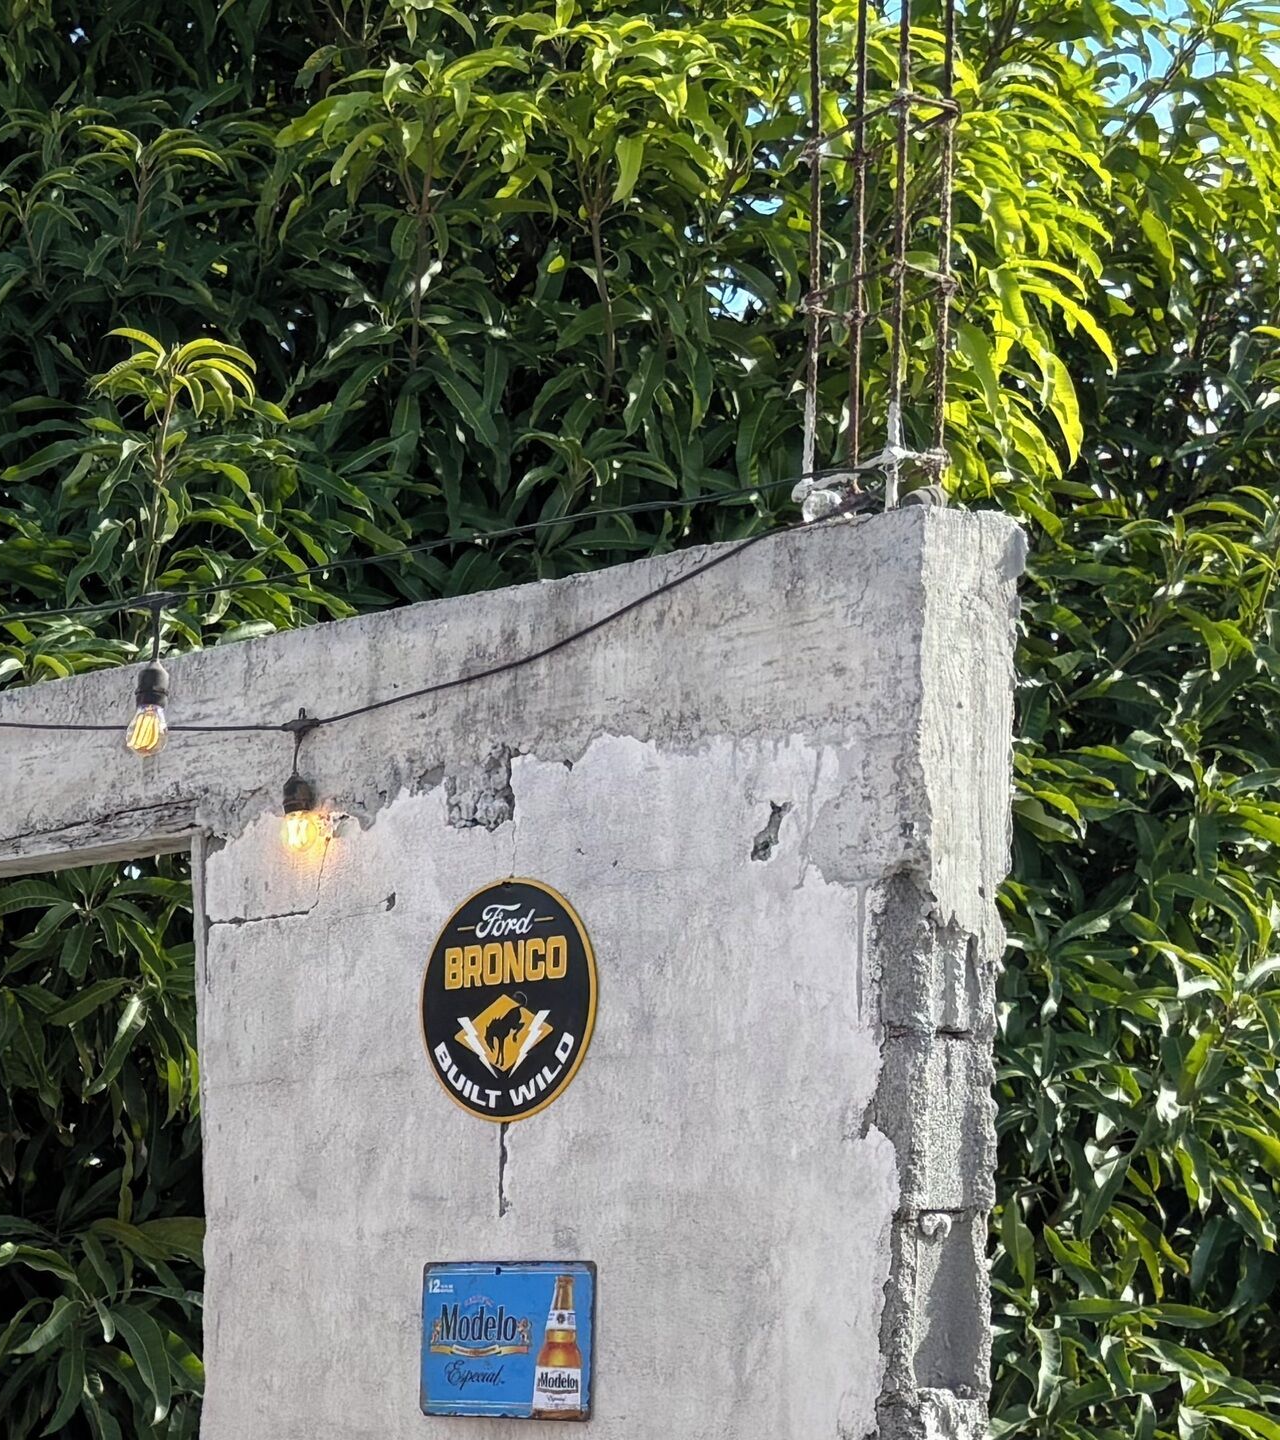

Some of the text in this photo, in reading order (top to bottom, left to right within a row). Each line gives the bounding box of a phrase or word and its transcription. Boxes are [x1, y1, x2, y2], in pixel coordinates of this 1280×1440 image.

[475, 903, 536, 938] Ford
[444, 935, 568, 990] BRONCO
[434, 1031, 575, 1108] BUILT WILD
[440, 1303, 517, 1342] Modelo
[540, 1371, 576, 1389] Modelo
